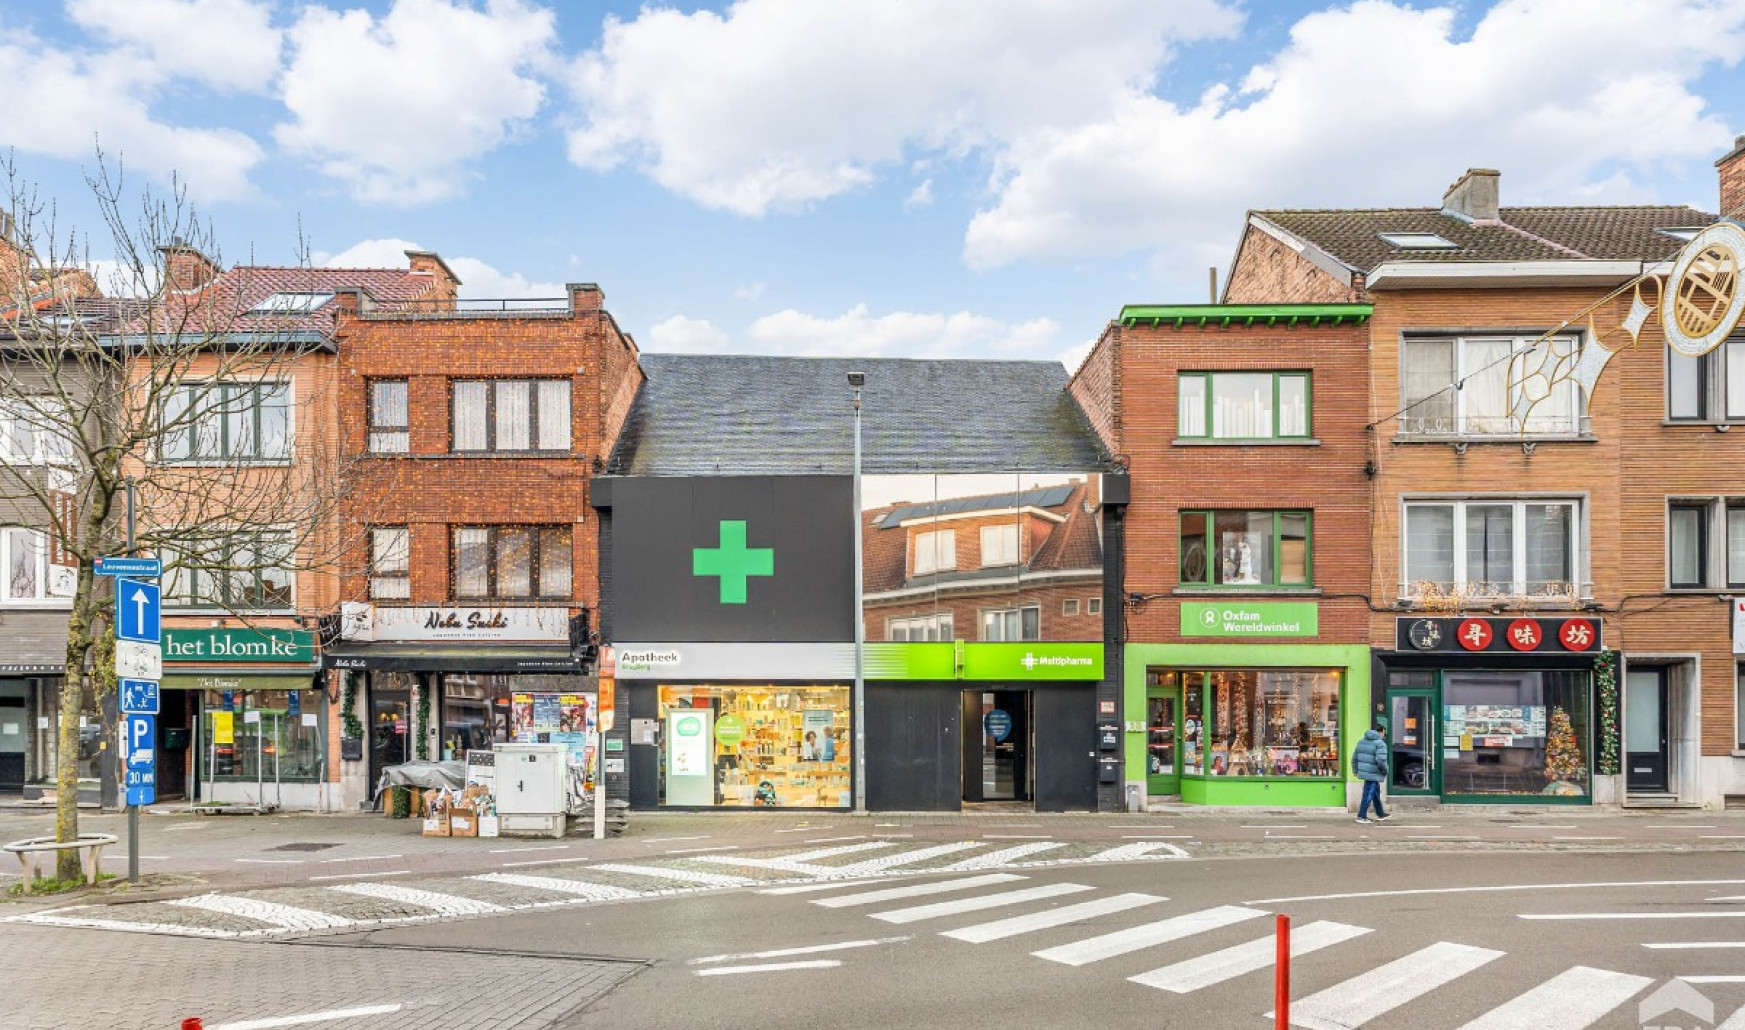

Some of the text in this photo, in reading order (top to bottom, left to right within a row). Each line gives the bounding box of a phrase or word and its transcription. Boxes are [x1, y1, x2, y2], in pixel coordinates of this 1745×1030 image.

[1223, 610, 1260, 621] Oxfam
[1223, 622, 1300, 632] Wereldwinkel
[165, 634, 205, 655] het
[622, 652, 677, 663] Apotheek
[1040, 656, 1093, 667] Multipharma
[134, 719, 149, 748] P
[129, 771, 141, 784] 30
